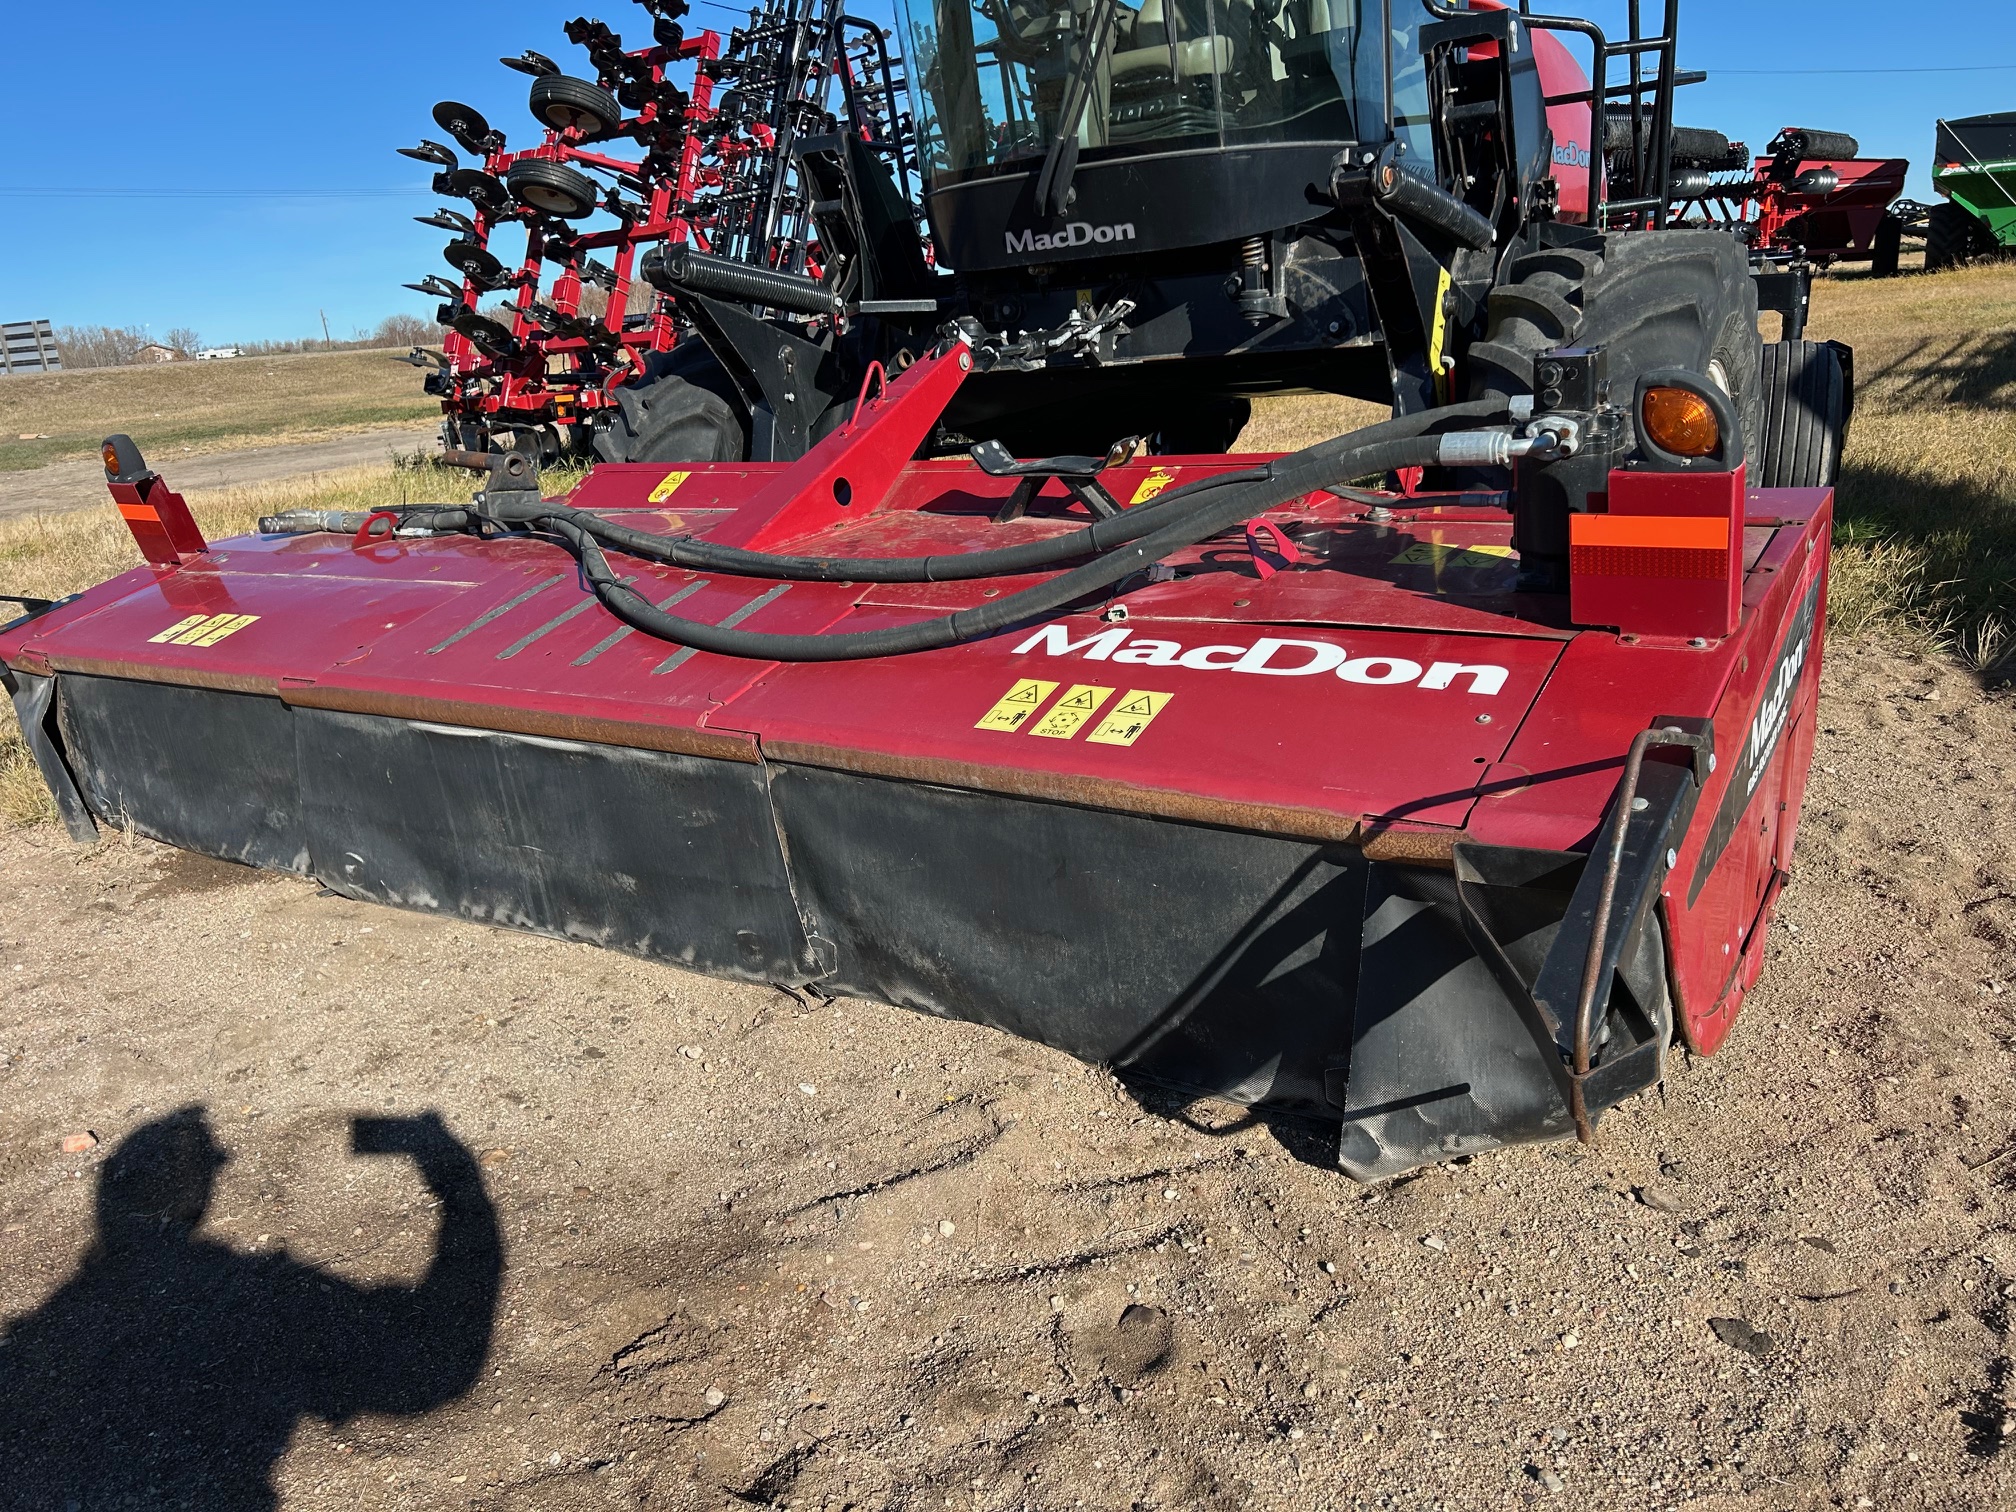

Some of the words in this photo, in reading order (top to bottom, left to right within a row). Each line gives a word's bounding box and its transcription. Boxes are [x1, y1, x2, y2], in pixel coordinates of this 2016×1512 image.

[1004, 222, 1136, 254] MacDon
[1010, 624, 1510, 696] MacDon
[1749, 638, 1803, 769] MacDon
[1040, 728, 1066, 736] STOP
